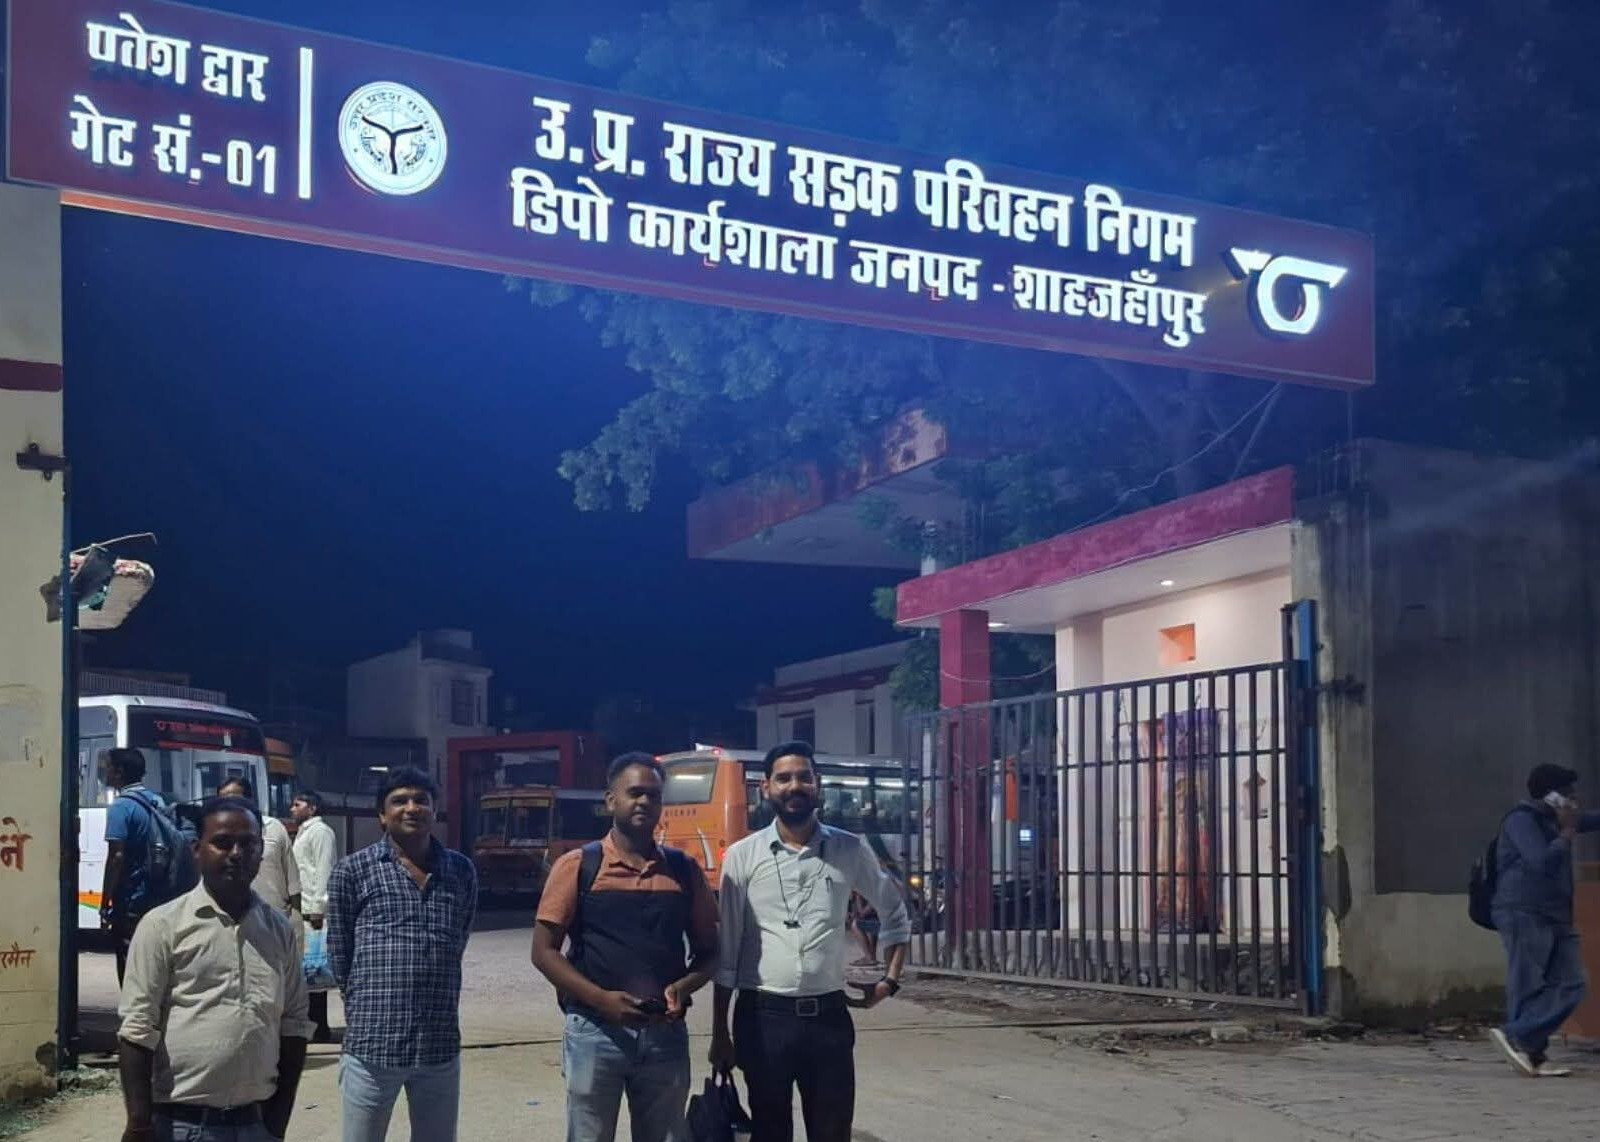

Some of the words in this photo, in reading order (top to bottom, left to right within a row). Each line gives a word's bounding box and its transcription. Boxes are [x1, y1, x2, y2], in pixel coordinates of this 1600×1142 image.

[200, 44, 270, 102] द्वार
[69, 94, 138, 167] गेट
[662, 122, 776, 197] राज्य
[787, 146, 901, 228] सड़क
[912, 158, 1074, 247] परिवहन
[1083, 183, 1197, 267] निगम
[510, 167, 614, 243] डिपो
[627, 200, 839, 280] कार्यशाला
[849, 239, 982, 301] जनपद
[1013, 265, 1209, 348] शाहजहाँपुर
